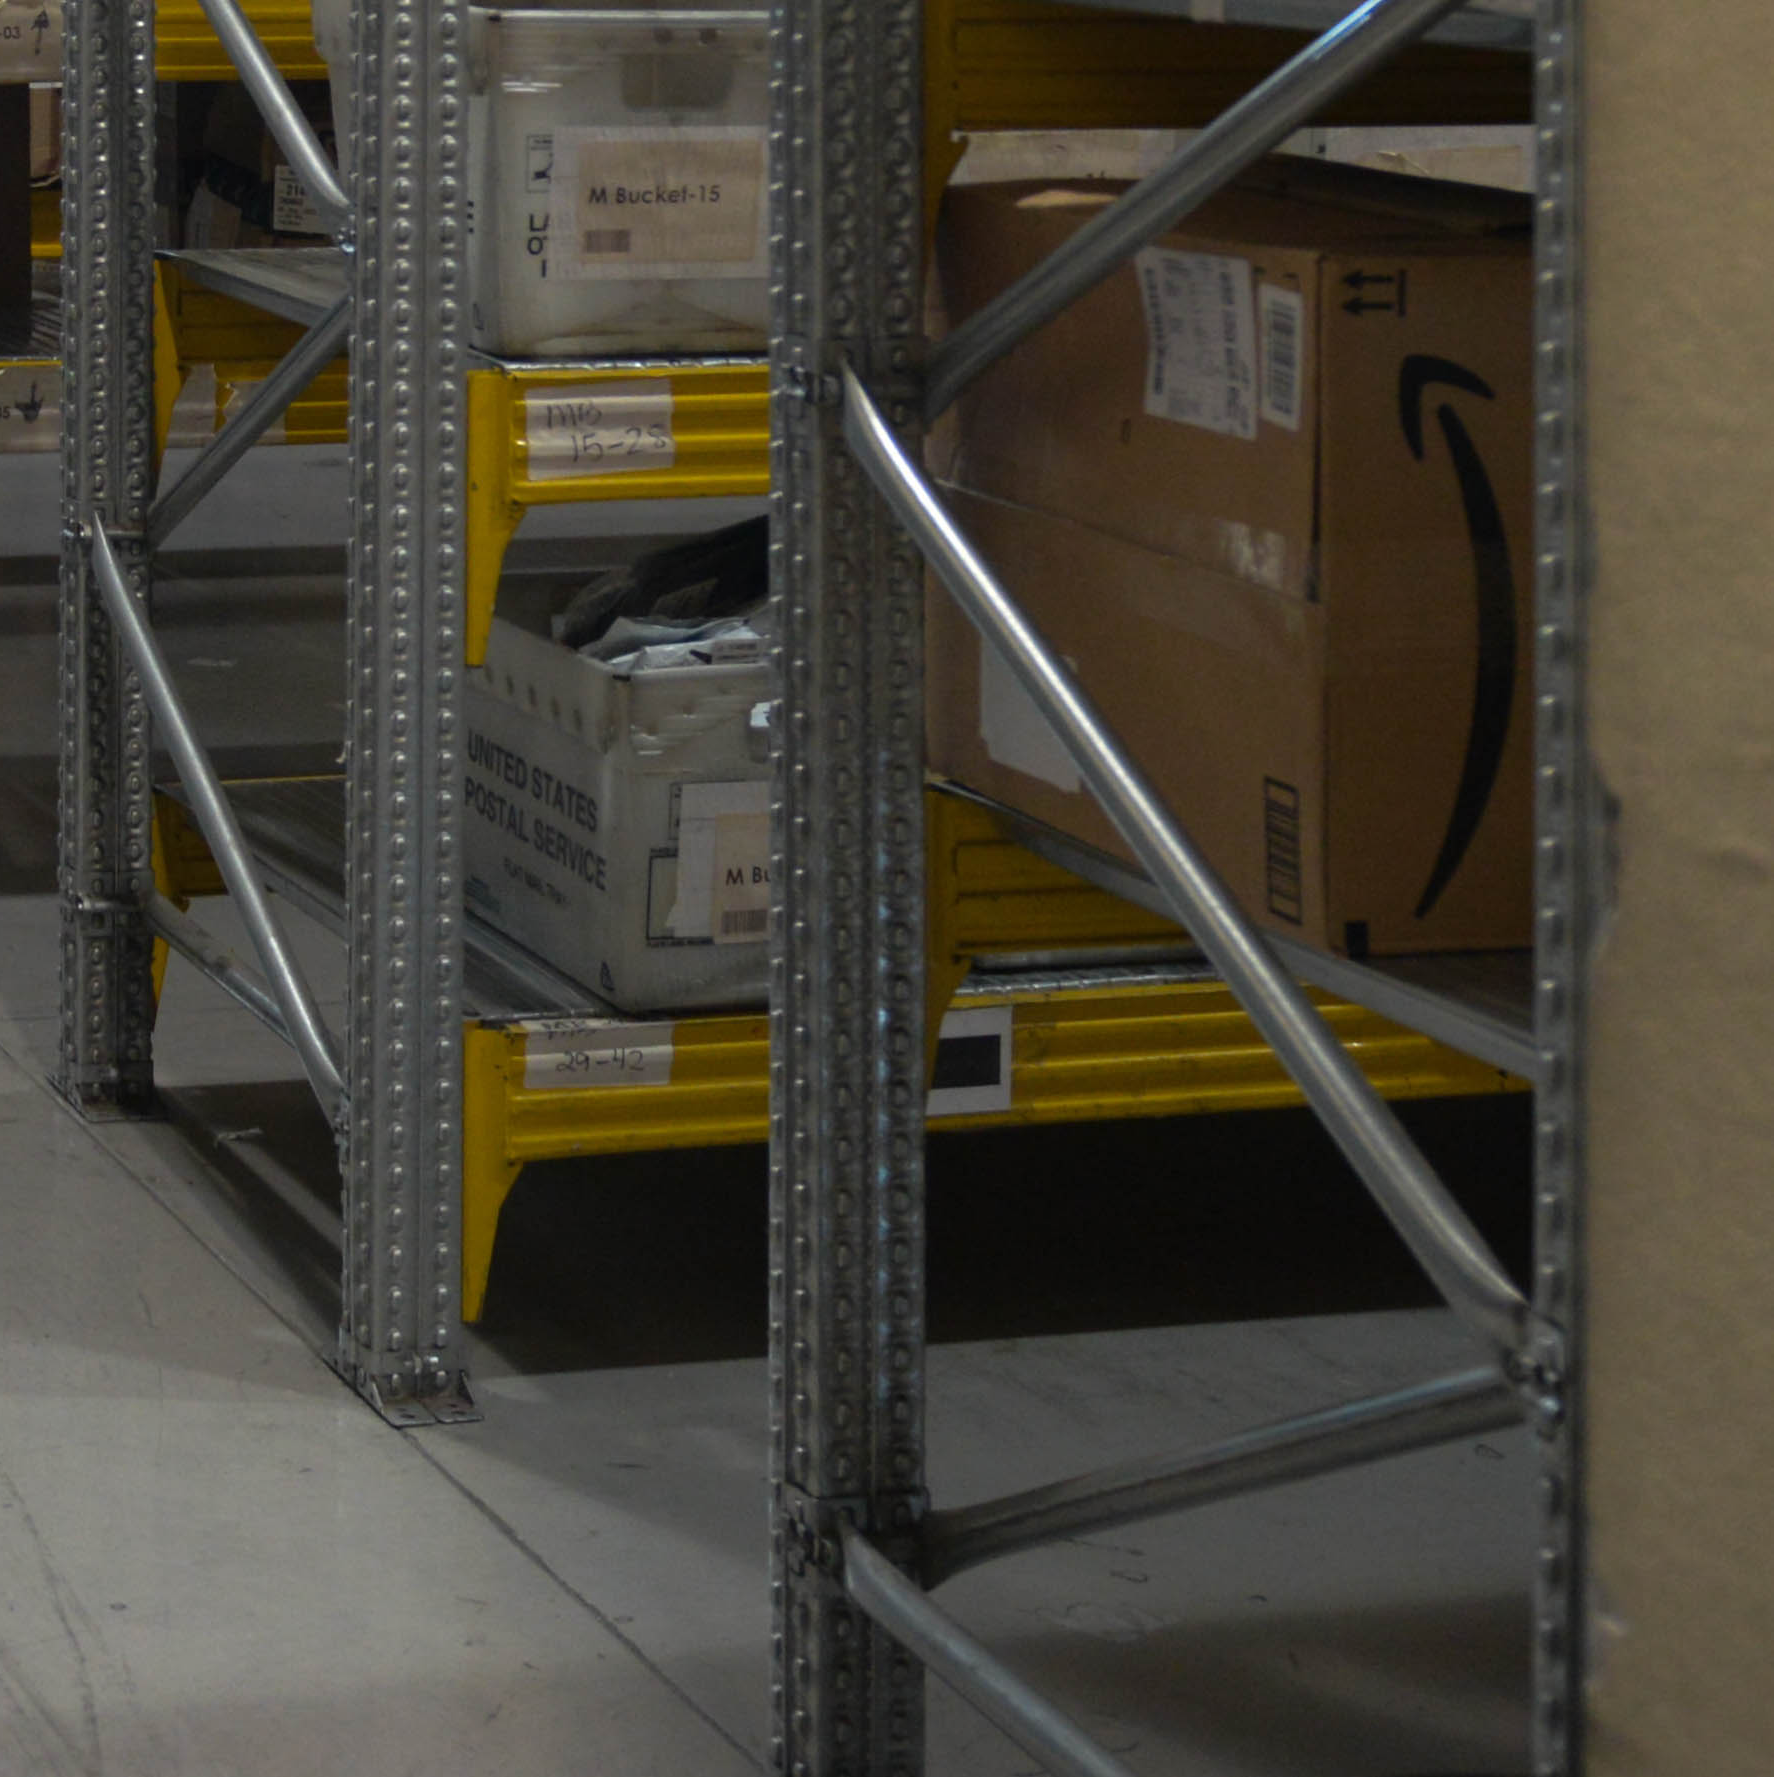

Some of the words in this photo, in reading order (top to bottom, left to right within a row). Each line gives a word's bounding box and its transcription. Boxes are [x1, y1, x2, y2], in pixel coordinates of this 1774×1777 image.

[588, 186, 607, 204] M
[615, 184, 721, 205] Bucket-15
[467, 729, 528, 790] UNITED
[532, 767, 598, 832] STATES
[465, 776, 530, 844] POSTAL
[534, 817, 607, 892] SERVICE
[726, 868, 744, 885] M
